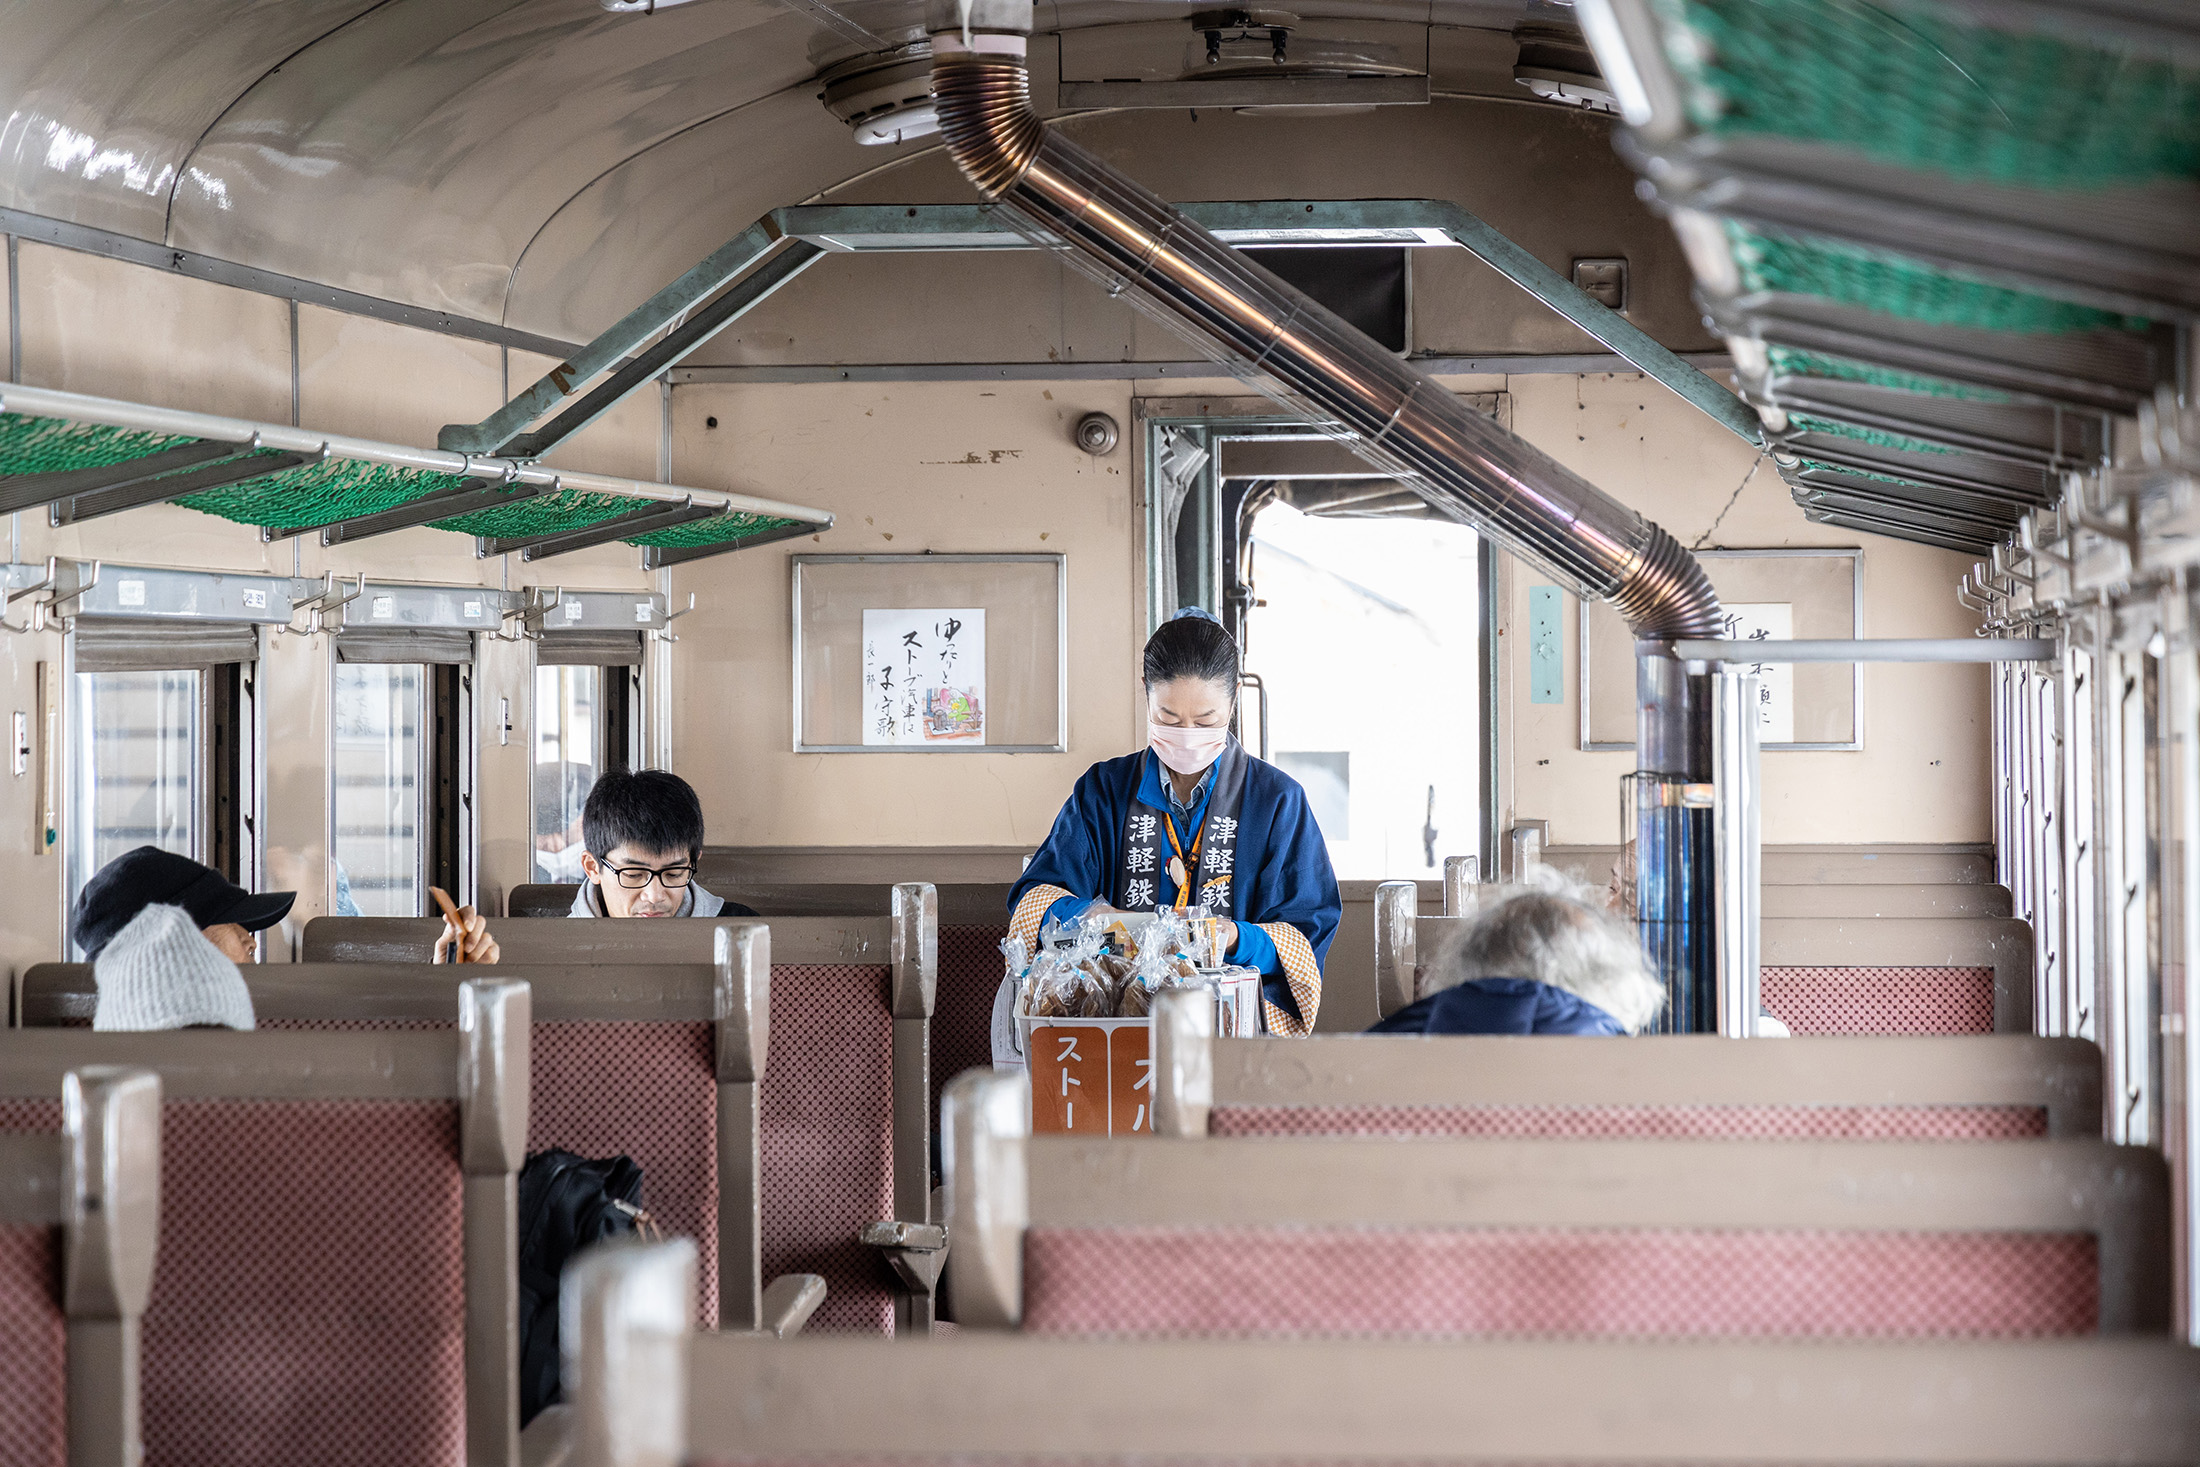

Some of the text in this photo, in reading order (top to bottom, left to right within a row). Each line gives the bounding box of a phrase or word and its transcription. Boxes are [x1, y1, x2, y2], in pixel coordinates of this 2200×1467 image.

[901, 630, 923, 735] ストーブ汽車に
[935, 617, 962, 684] ゆったりと
[874, 665, 896, 737] 子守歌
[1124, 814, 1157, 909] 津軽鉄
[1199, 816, 1239, 908] 津軽鉄
[1056, 1036, 1082, 1129] ストー
